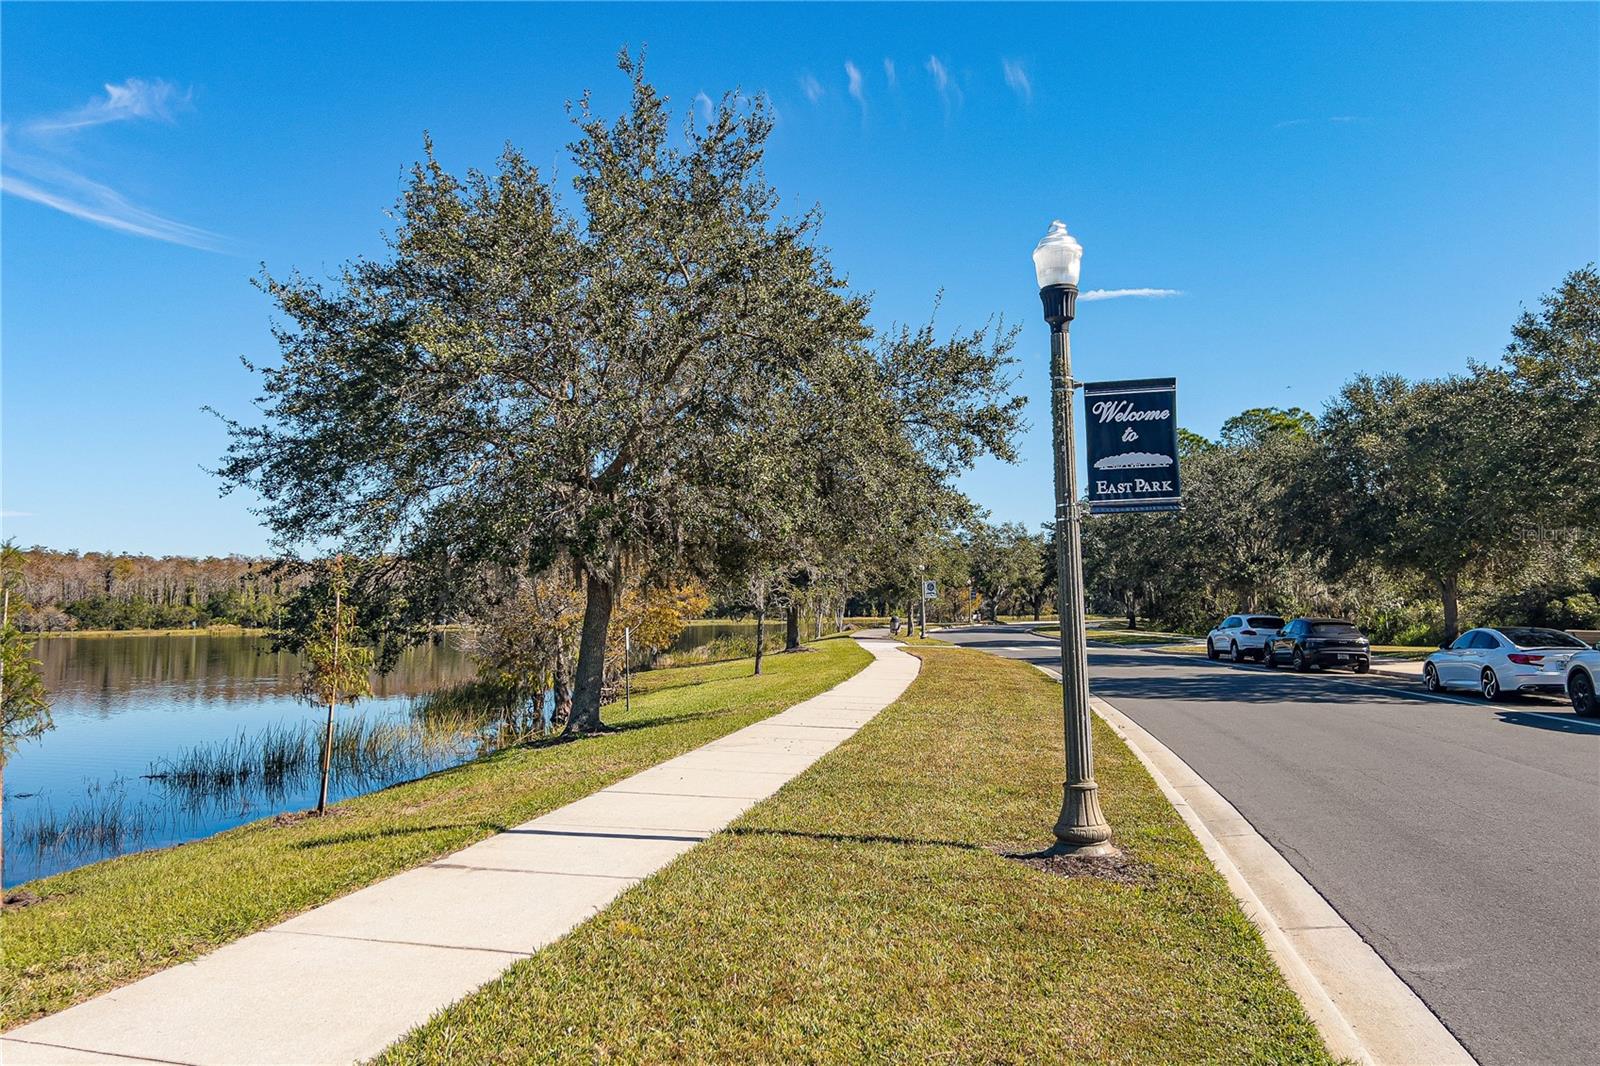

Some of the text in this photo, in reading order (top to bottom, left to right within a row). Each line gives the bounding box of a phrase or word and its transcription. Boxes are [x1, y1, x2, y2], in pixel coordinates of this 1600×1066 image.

[1092, 400, 1170, 423] Welcome
[1121, 426, 1139, 442] to
[1096, 478, 1173, 494] EAST PARK
